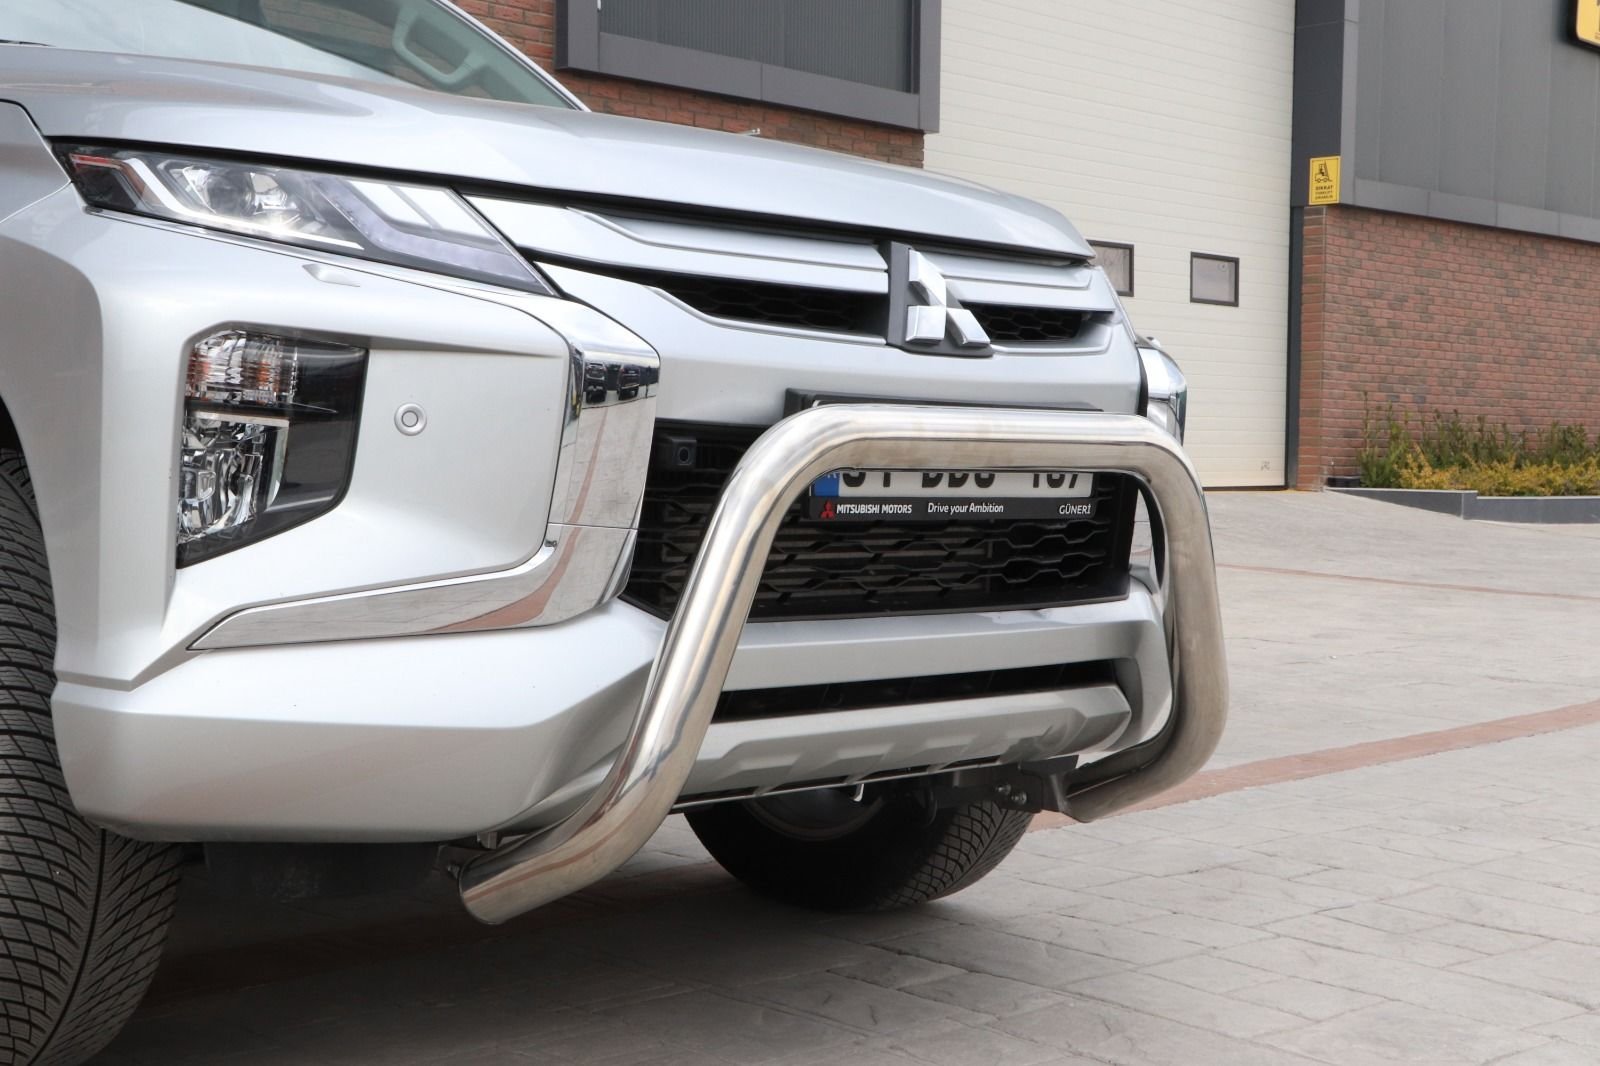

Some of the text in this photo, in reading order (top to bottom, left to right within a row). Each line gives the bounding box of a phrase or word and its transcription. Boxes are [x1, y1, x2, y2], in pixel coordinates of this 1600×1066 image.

[836, 504, 912, 514] MITSUBISHI MOTORS
[928, 502, 1004, 515] Drive your Ambition
